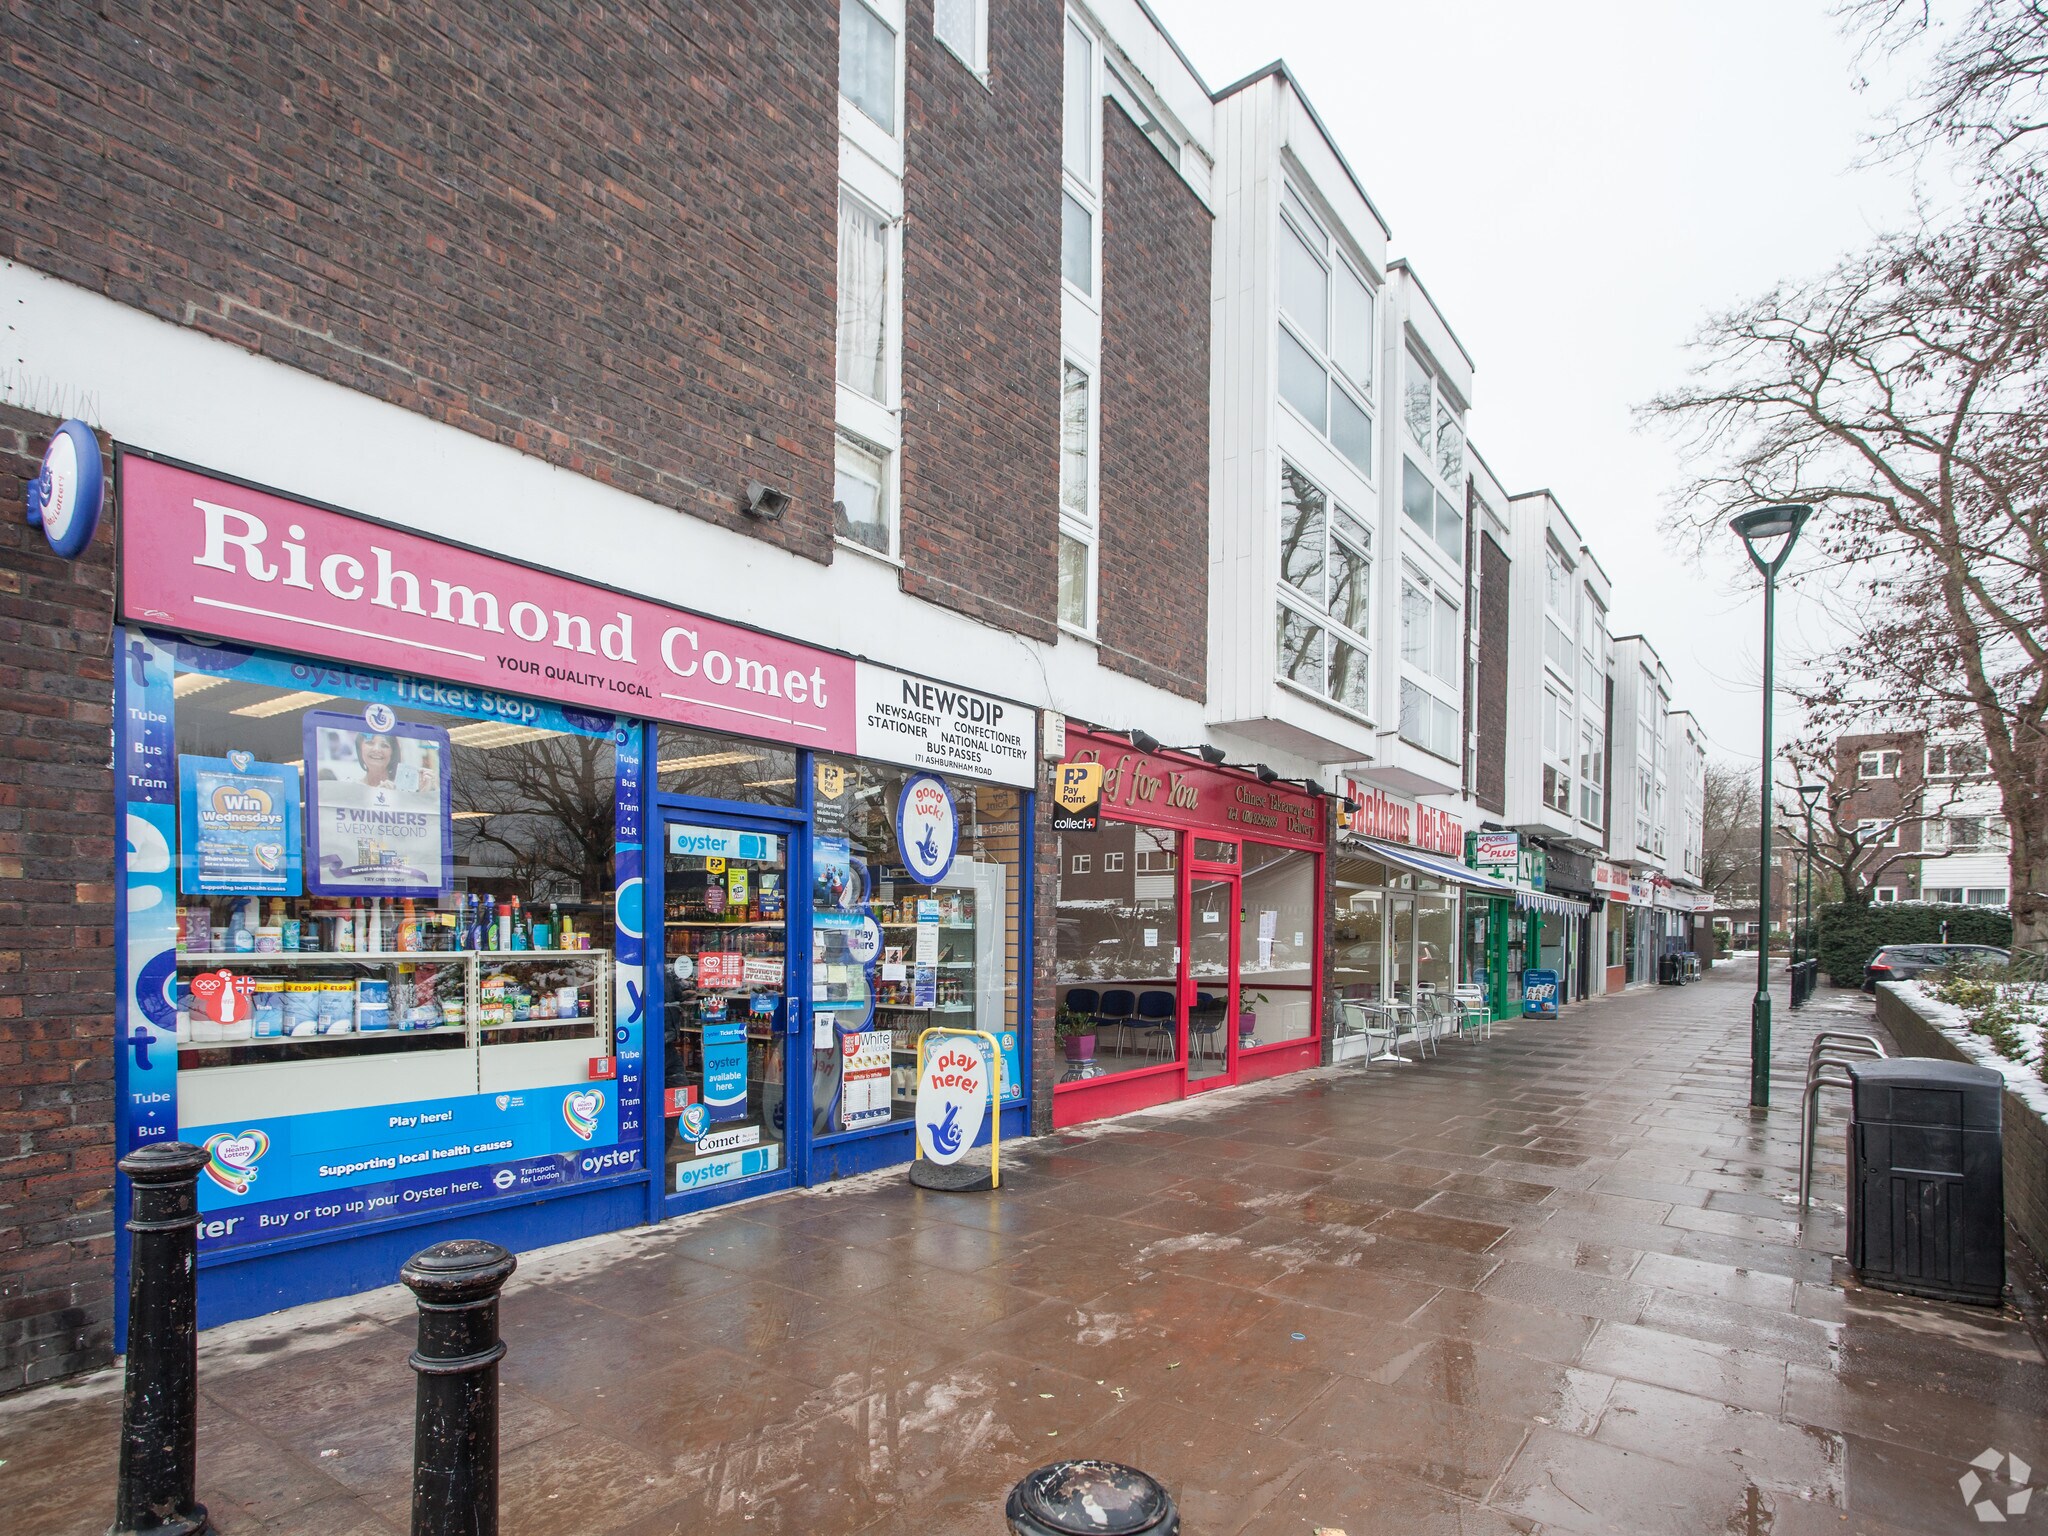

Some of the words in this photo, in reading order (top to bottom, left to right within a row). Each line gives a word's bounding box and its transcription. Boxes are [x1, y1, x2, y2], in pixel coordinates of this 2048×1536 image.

[192, 497, 638, 665] Richmond
[659, 626, 829, 709] Comet
[497, 655, 540, 675] YOUR
[545, 666, 605, 688] QUALITY
[609, 679, 652, 698] LOCAL
[290, 661, 385, 692] oyster
[391, 674, 478, 708] Ticket
[481, 691, 536, 722] Stop
[902, 679, 1004, 727] NEWSDIP
[129, 708, 167, 723] Tube
[876, 702, 941, 727] NEWSAGENT
[954, 721, 1021, 746] CONFECTIONER
[868, 715, 928, 738] STATIONER
[941, 732, 989, 752] NATIONAL
[991, 744, 1027, 760] LOTTERY
[134, 742, 162, 756] Bus
[927, 742, 946, 756] BUS
[949, 749, 982, 763] PASSES
[619, 753, 639, 764] Tube
[925, 756, 973, 772] ASHBURNHAM
[974, 766, 993, 776] ROAD
[129, 775, 168, 789] Tram
[621, 778, 637, 788] Bus
[825, 780, 833, 788] Pay
[1072, 749, 1130, 803] ef
[1126, 759, 1162, 806] for
[1166, 771, 1198, 810] You
[916, 787, 944, 804] good
[1063, 786, 1079, 798] Pay
[1063, 794, 1086, 804] Point
[223, 794, 261, 811] Win
[619, 802, 639, 812] Tram
[1236, 785, 1266, 808] Chinese
[1269, 793, 1301, 819] Takeaway
[1303, 803, 1315, 818] and
[202, 811, 283, 824] Wednesdays
[335, 808, 346, 820] 5
[350, 809, 427, 826] WINNERS
[916, 803, 943, 821] luck!
[336, 823, 375, 834] EVERY
[377, 826, 427, 837] SECOND
[621, 825, 637, 836] DLR
[1288, 817, 1315, 839] Delivery
[1417, 803, 1463, 856] Deli-Shop
[678, 835, 727, 853] oyster
[1490, 849, 1516, 857] PLUS
[855, 930, 873, 941] Play
[861, 1033, 890, 1046] White
[620, 1049, 640, 1060] Tube
[938, 1051, 977, 1072] play
[709, 1057, 741, 1071] oyster
[622, 1074, 637, 1083] Bus
[709, 1072, 741, 1082] available
[931, 1074, 978, 1094] here!
[716, 1082, 735, 1091] here.
[133, 1092, 171, 1104] Tube
[620, 1097, 640, 1106] Tram
[389, 1116, 417, 1128] Play
[420, 1110, 453, 1124] here!
[622, 1120, 639, 1130] DLR
[138, 1125, 166, 1137] Bus
[697, 1134, 740, 1150] Comet
[224, 1150, 251, 1159] Lottery
[225, 1145, 250, 1154] Health
[319, 1157, 396, 1177] Supporting
[399, 1150, 430, 1164] local
[432, 1144, 471, 1159] health
[473, 1139, 513, 1153] causes
[582, 1149, 637, 1173] oyster
[521, 1164, 556, 1176] Transport
[682, 1161, 731, 1186] oyster
[520, 1175, 532, 1184] for
[533, 1172, 560, 1182] London
[259, 1212, 290, 1228] Buy
[294, 1209, 311, 1221] or
[315, 1205, 341, 1220] top
[346, 1200, 365, 1215] up
[368, 1194, 400, 1211] your
[403, 1184, 448, 1204] Oyster
[451, 1179, 483, 1194] here.
